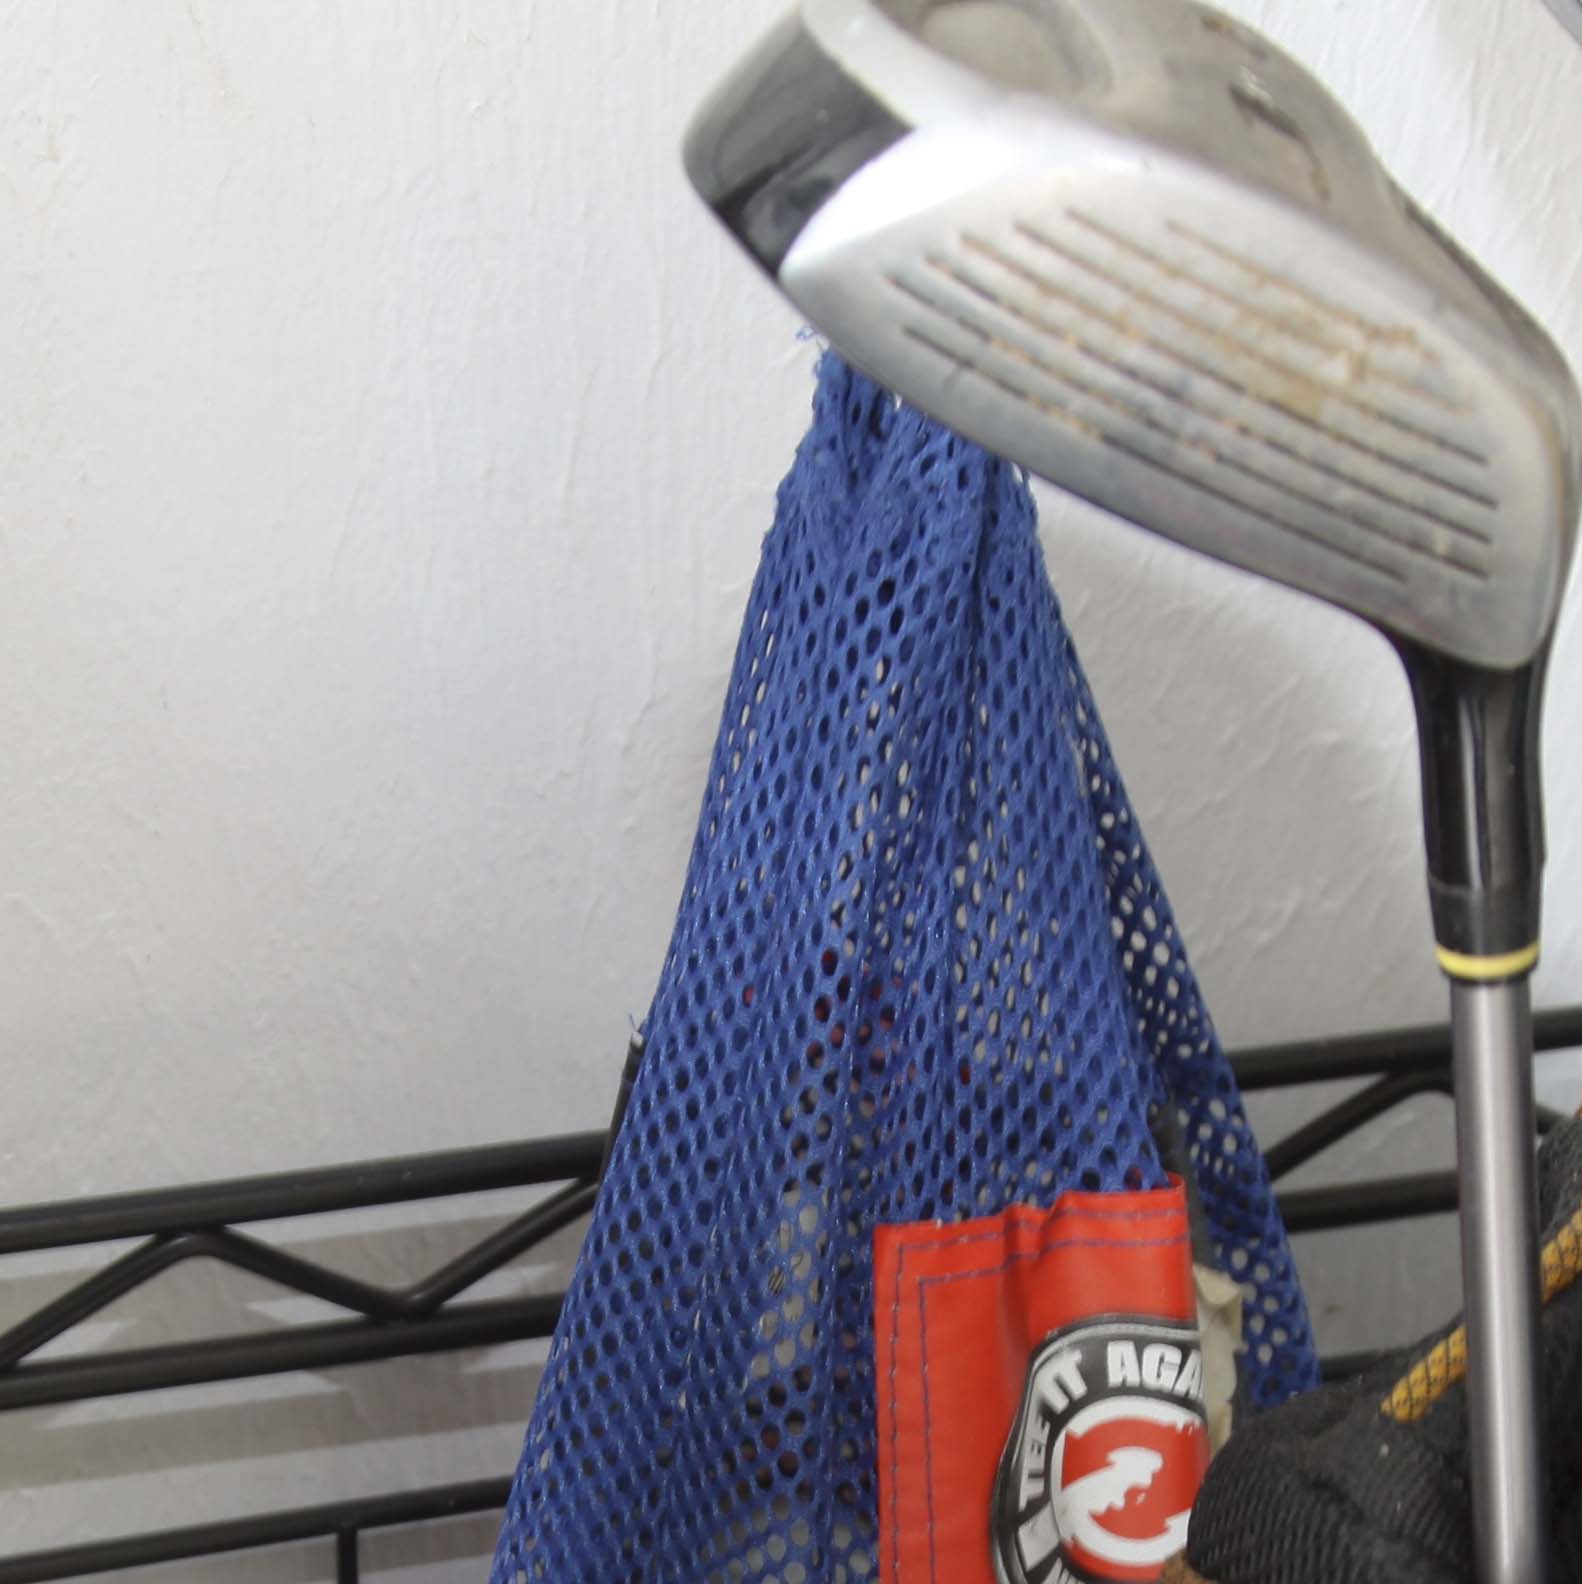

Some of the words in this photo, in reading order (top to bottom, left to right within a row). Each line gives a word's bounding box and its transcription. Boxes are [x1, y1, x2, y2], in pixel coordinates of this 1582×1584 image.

[1018, 1418, 1051, 1513] TEE
[1040, 1348, 1088, 1415] IT
[1106, 1341, 1203, 1399] AGA
